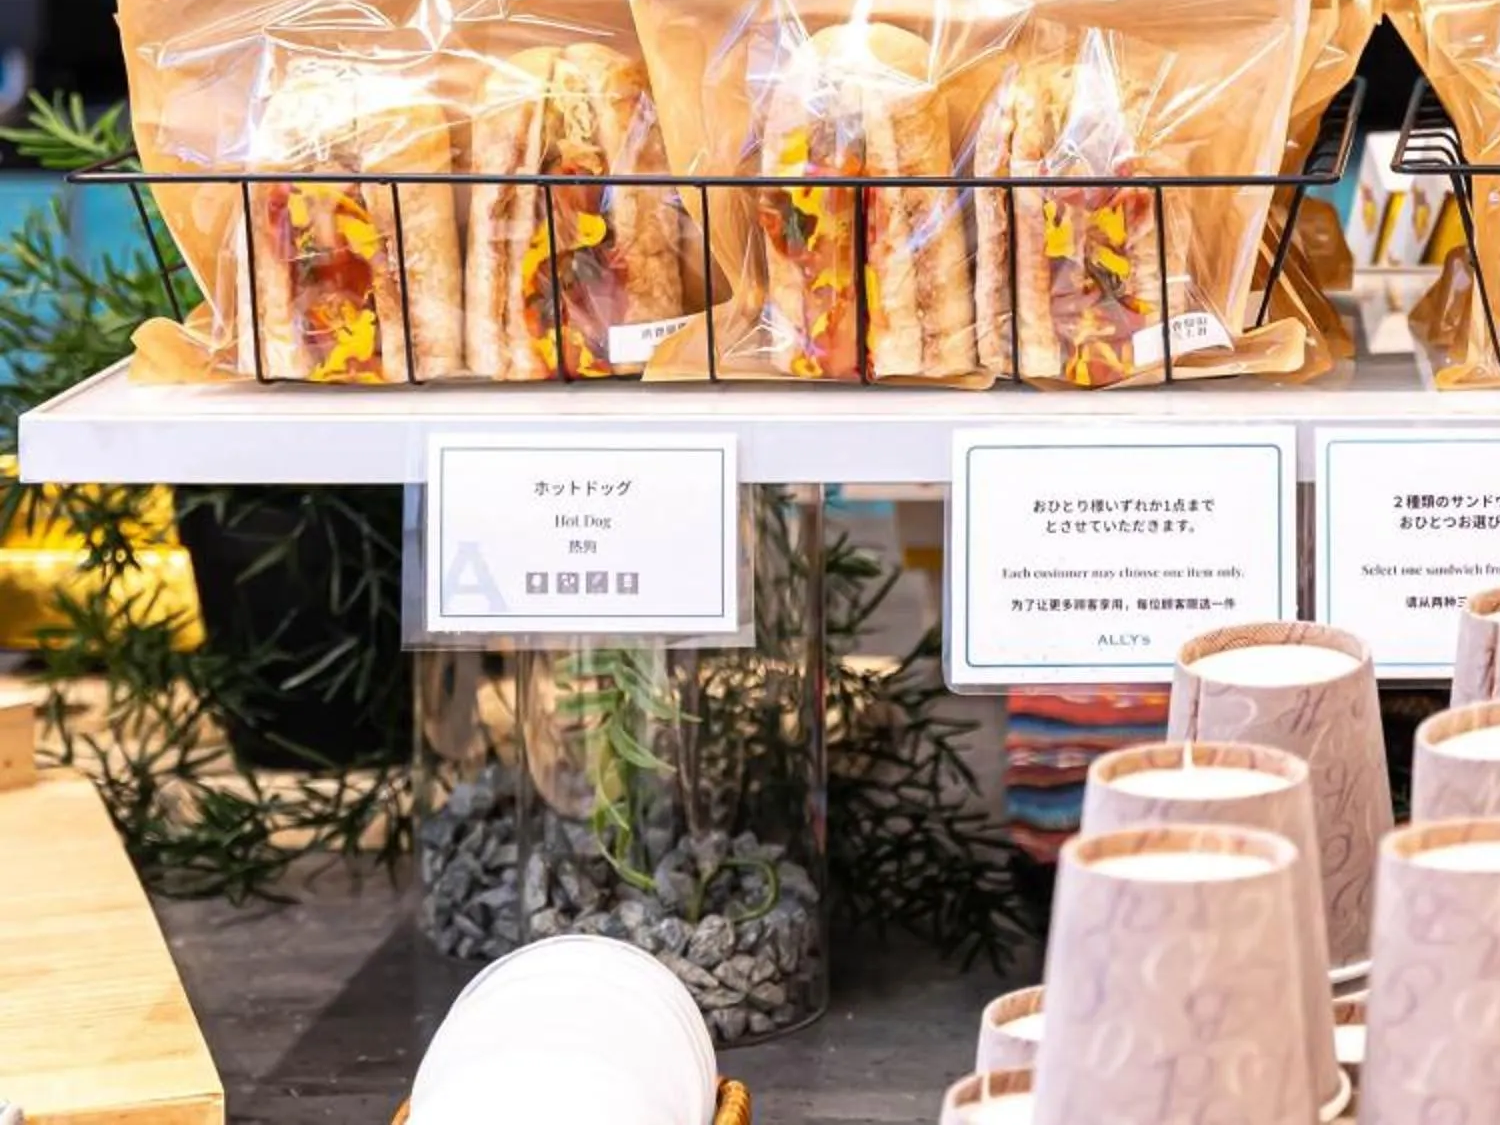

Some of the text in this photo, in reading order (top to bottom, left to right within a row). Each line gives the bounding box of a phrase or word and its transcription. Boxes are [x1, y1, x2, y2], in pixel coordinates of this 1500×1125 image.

[534, 479, 632, 497] ホットドッグ
[1033, 497, 1215, 514] おひとり様いずれか1点まで
[555, 514, 611, 531] Hot Dog
[1046, 518, 1195, 534] とさせていただきます。
[1002, 565, 1244, 581] Each customer may choose one item only.
[1361, 563, 1397, 577] Select
[1401, 566, 1422, 576] one
[1426, 562, 1483, 577] sandwich
[1097, 633, 1151, 647] ALLY's
